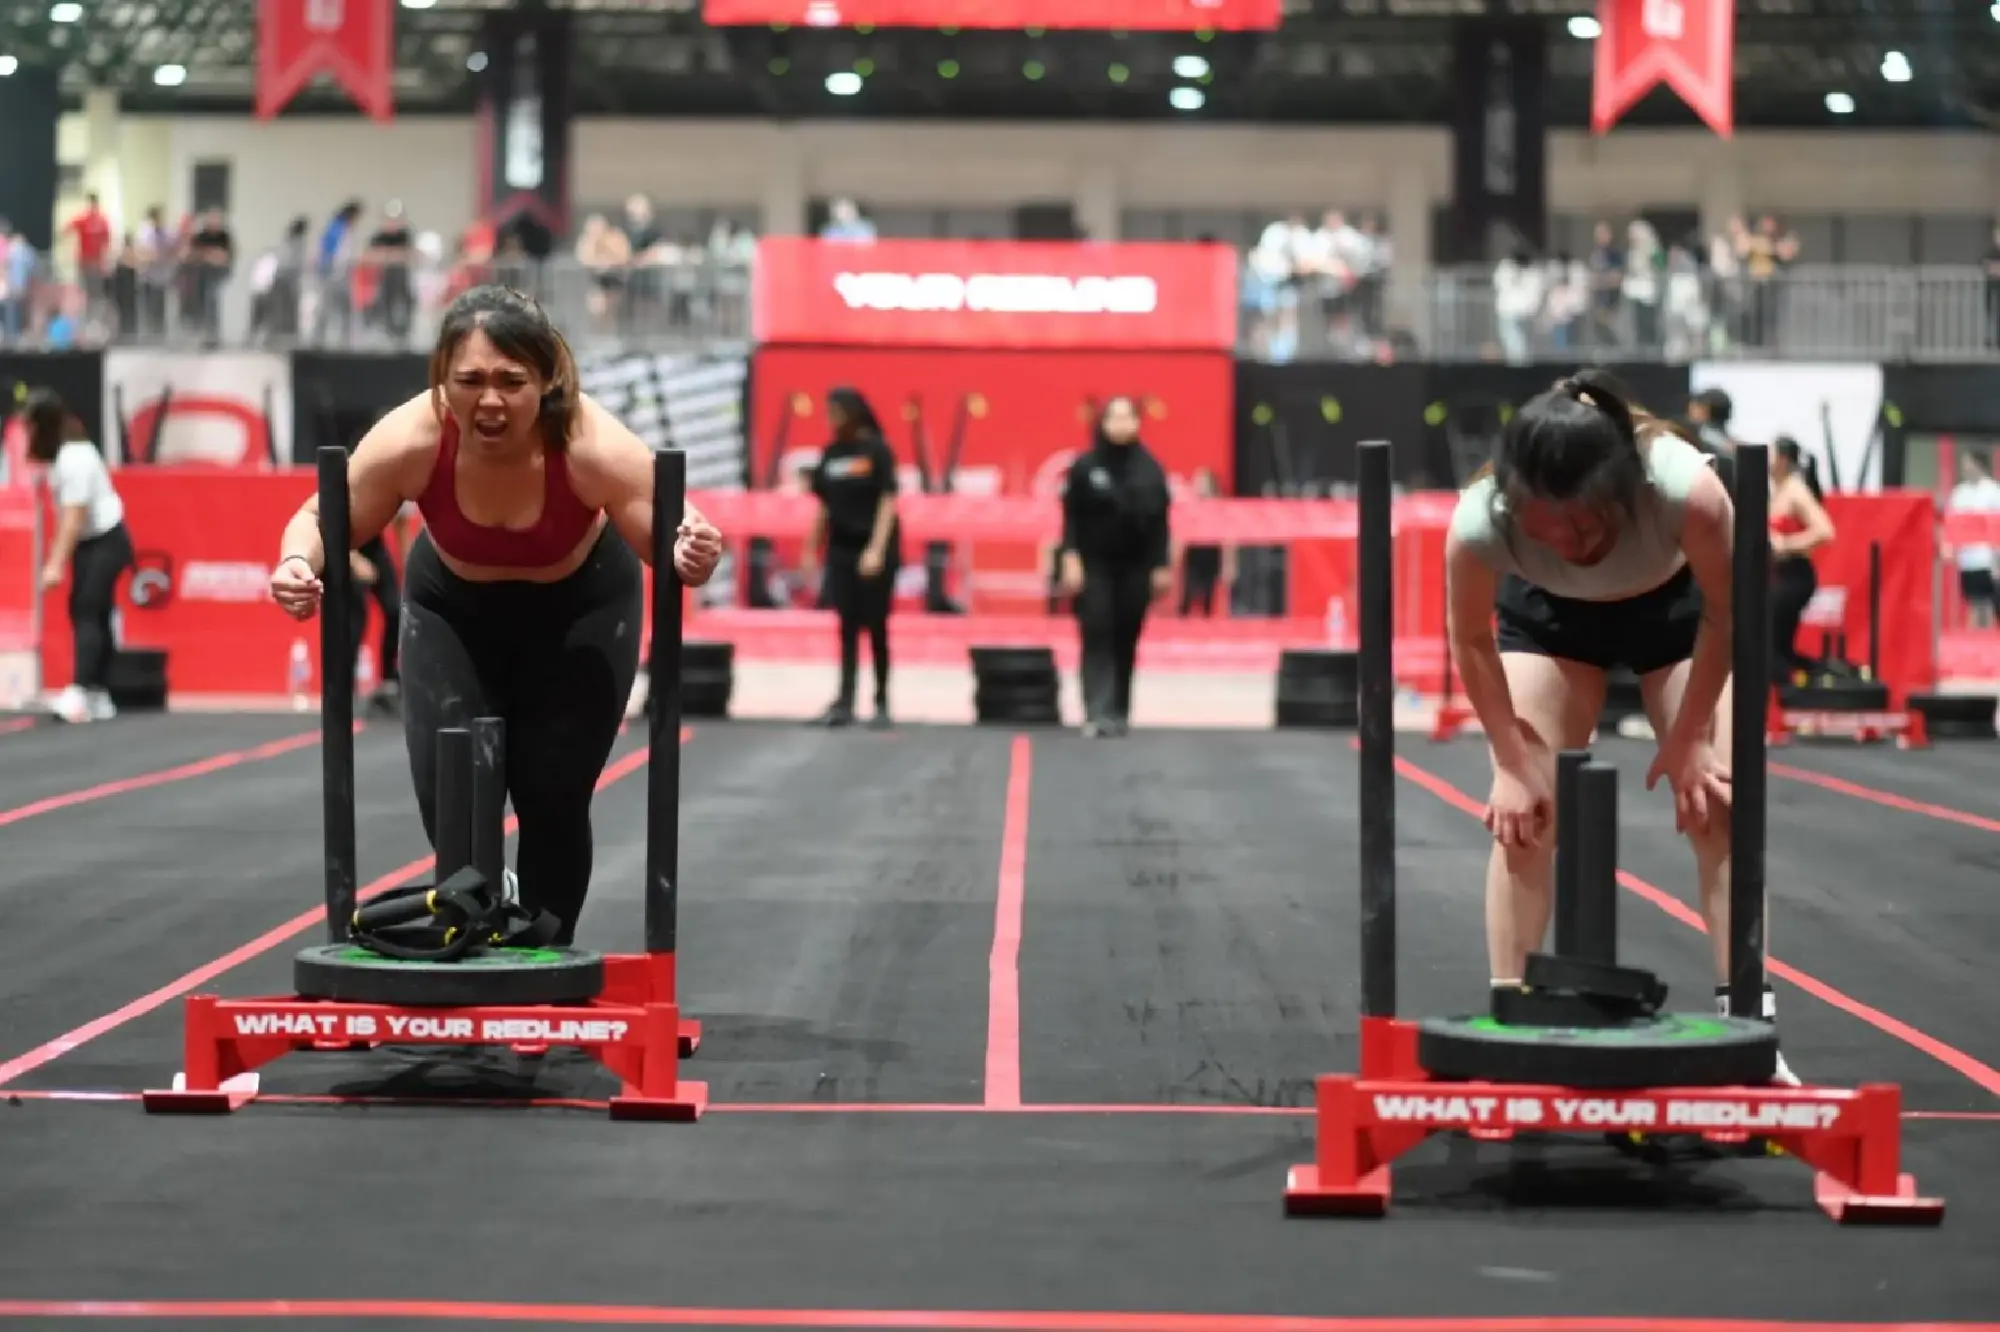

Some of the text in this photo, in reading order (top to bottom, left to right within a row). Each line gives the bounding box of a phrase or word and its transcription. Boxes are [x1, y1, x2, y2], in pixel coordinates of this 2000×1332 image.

[234, 1014, 629, 1042] WHAT IS YOUR REDLINE?
[1373, 1095, 1842, 1129] WHAT IS YOUR REDLINE?
